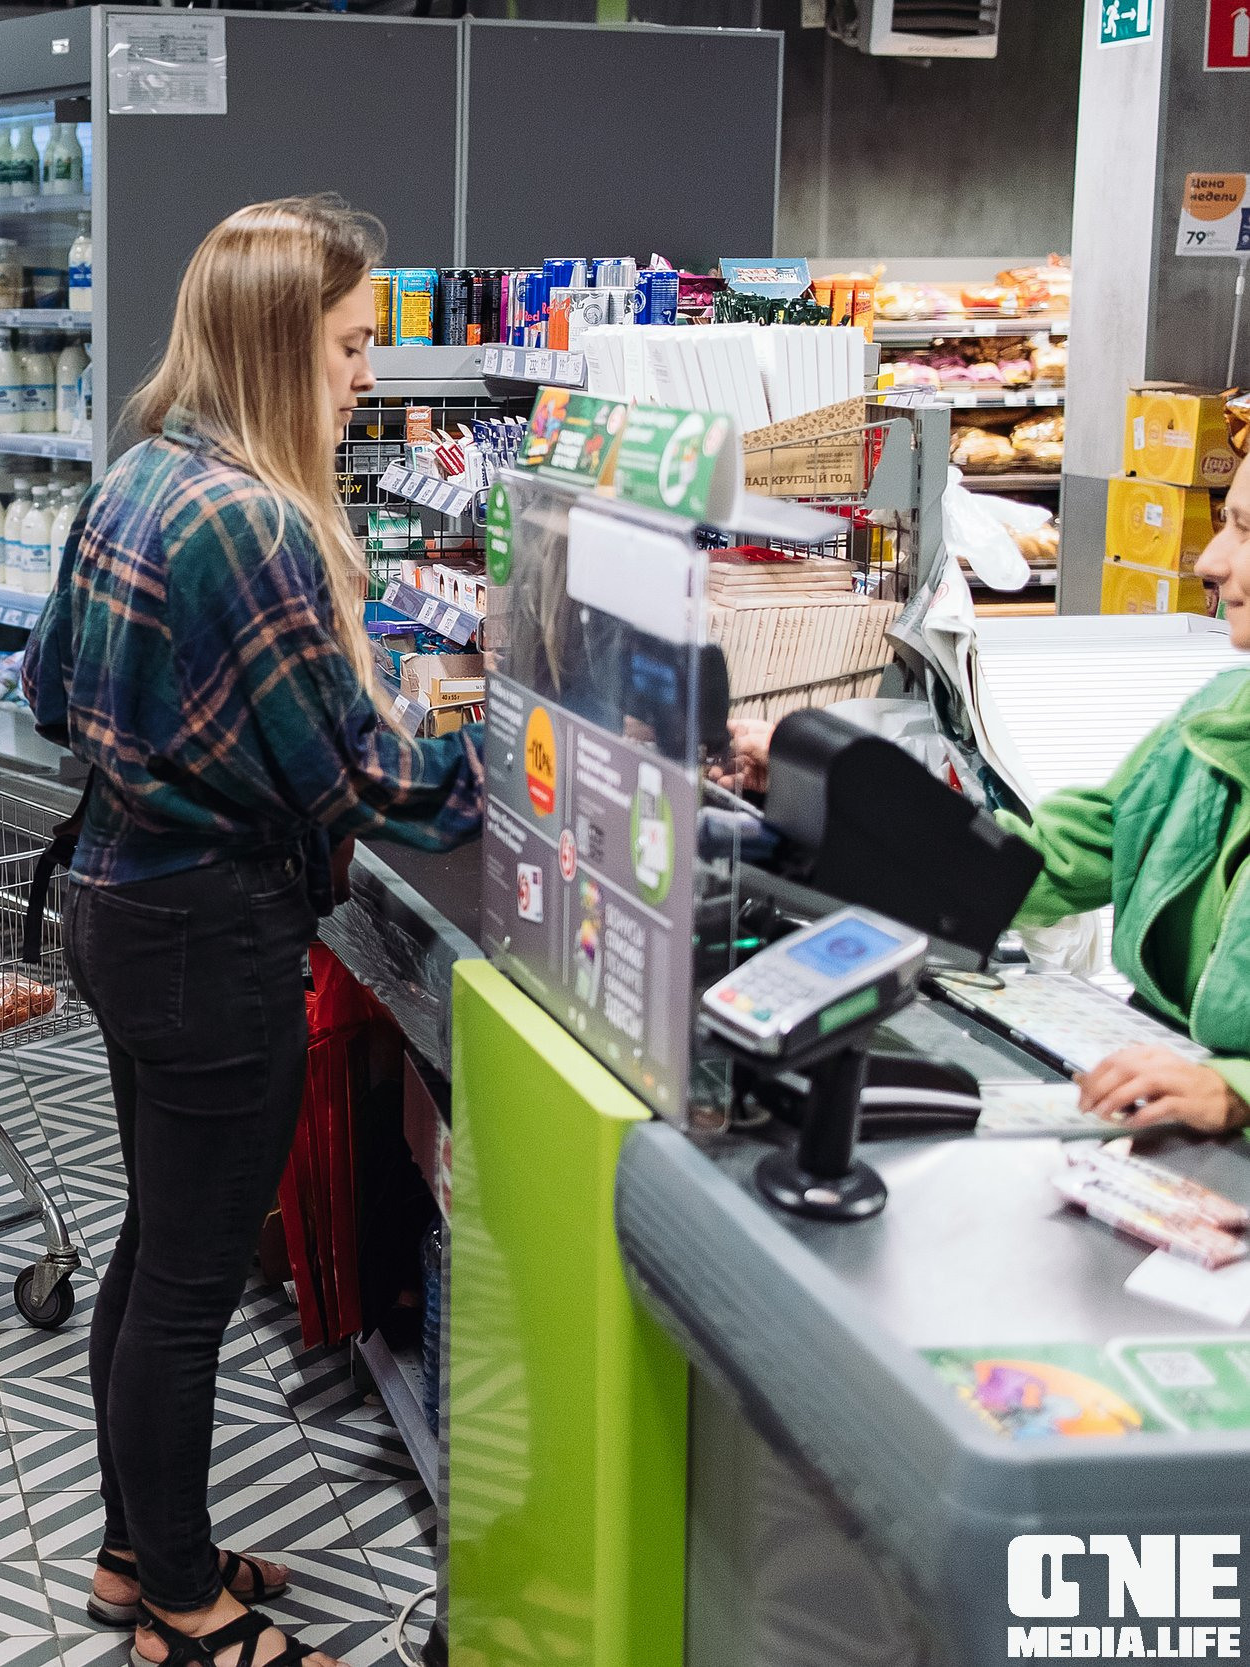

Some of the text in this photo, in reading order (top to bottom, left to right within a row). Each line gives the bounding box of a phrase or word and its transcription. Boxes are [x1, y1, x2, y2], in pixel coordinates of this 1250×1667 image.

[1191, 178, 1225, 189] Цена
[1187, 231, 1207, 245] 79
[744, 476, 769, 487] ЛАД
[830, 473, 852, 484] ГОД
